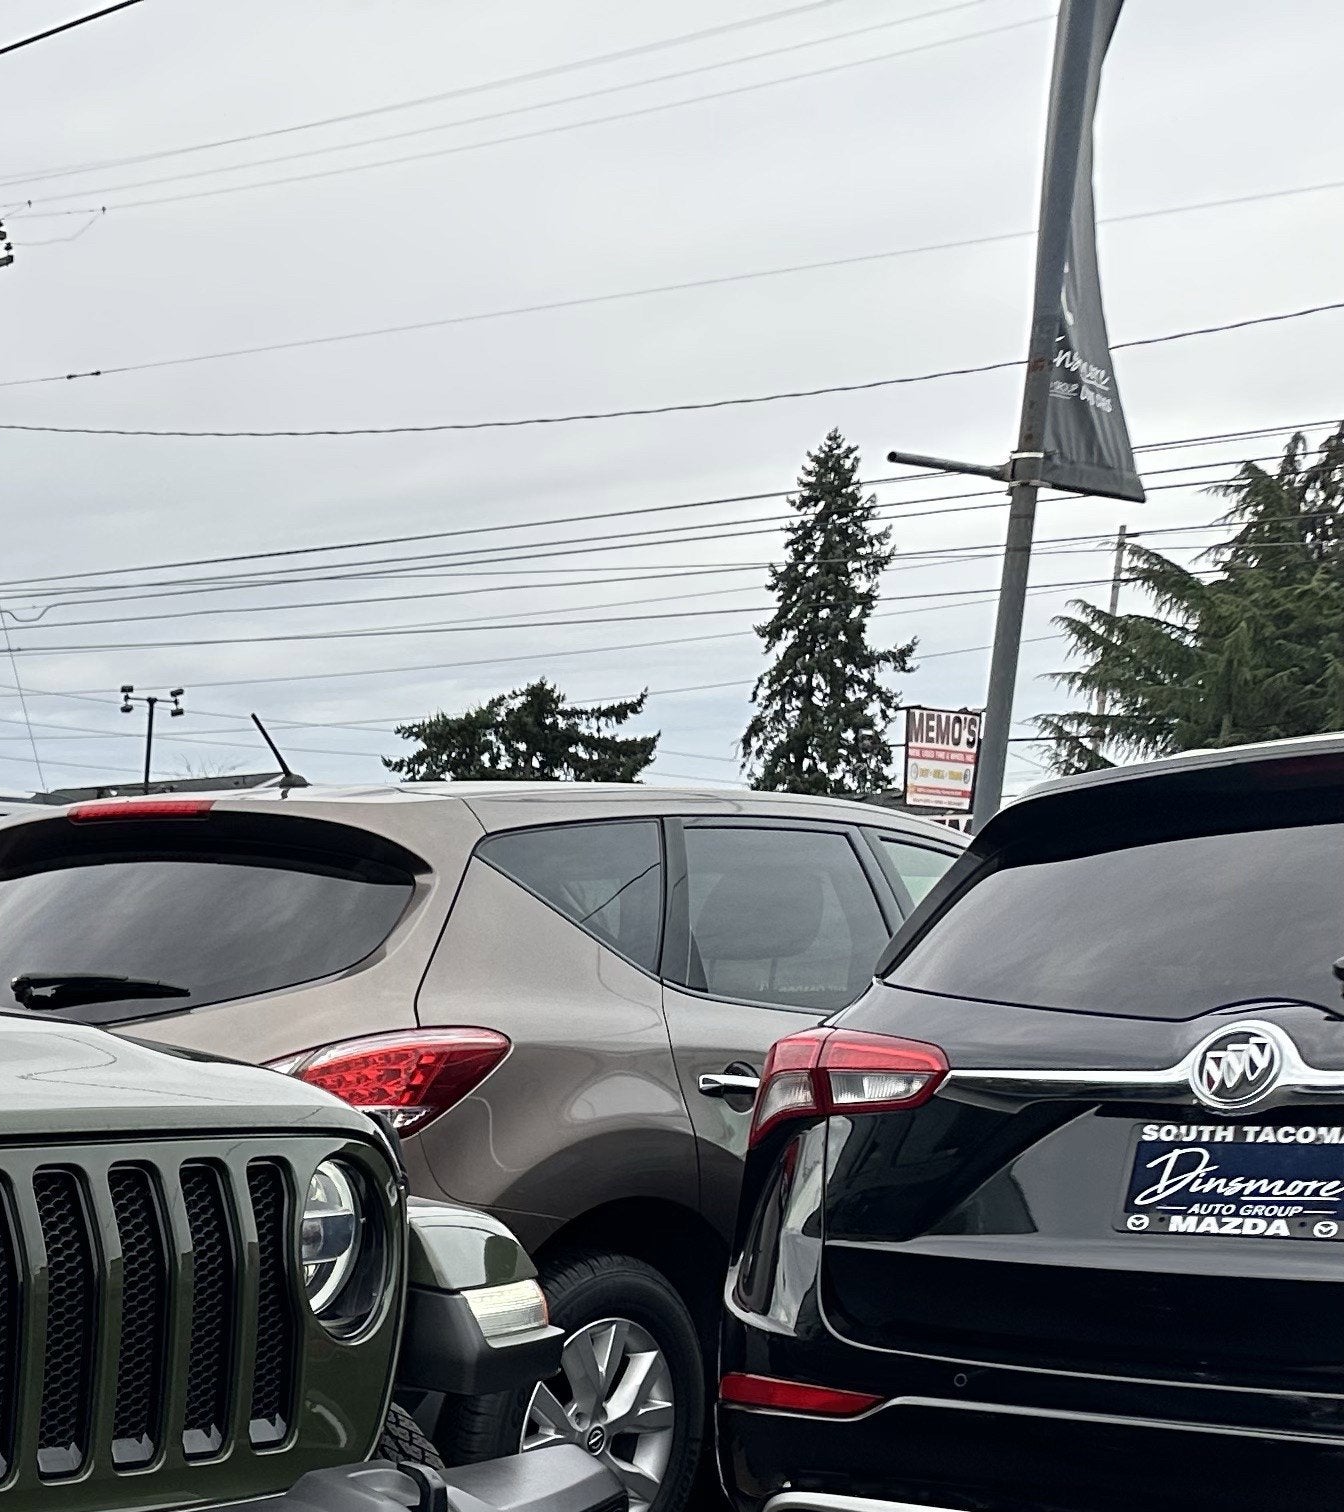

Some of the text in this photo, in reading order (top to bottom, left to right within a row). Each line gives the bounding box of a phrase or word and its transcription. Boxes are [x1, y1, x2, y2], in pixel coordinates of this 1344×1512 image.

[911, 712, 977, 748] MEMO'S
[1141, 1124, 1344, 1143] SOUTH TACOM
[1134, 1147, 1344, 1206] Dinsmore
[1187, 1203, 1303, 1217] AUTO GROUP
[1168, 1215, 1290, 1237] MAZDA
